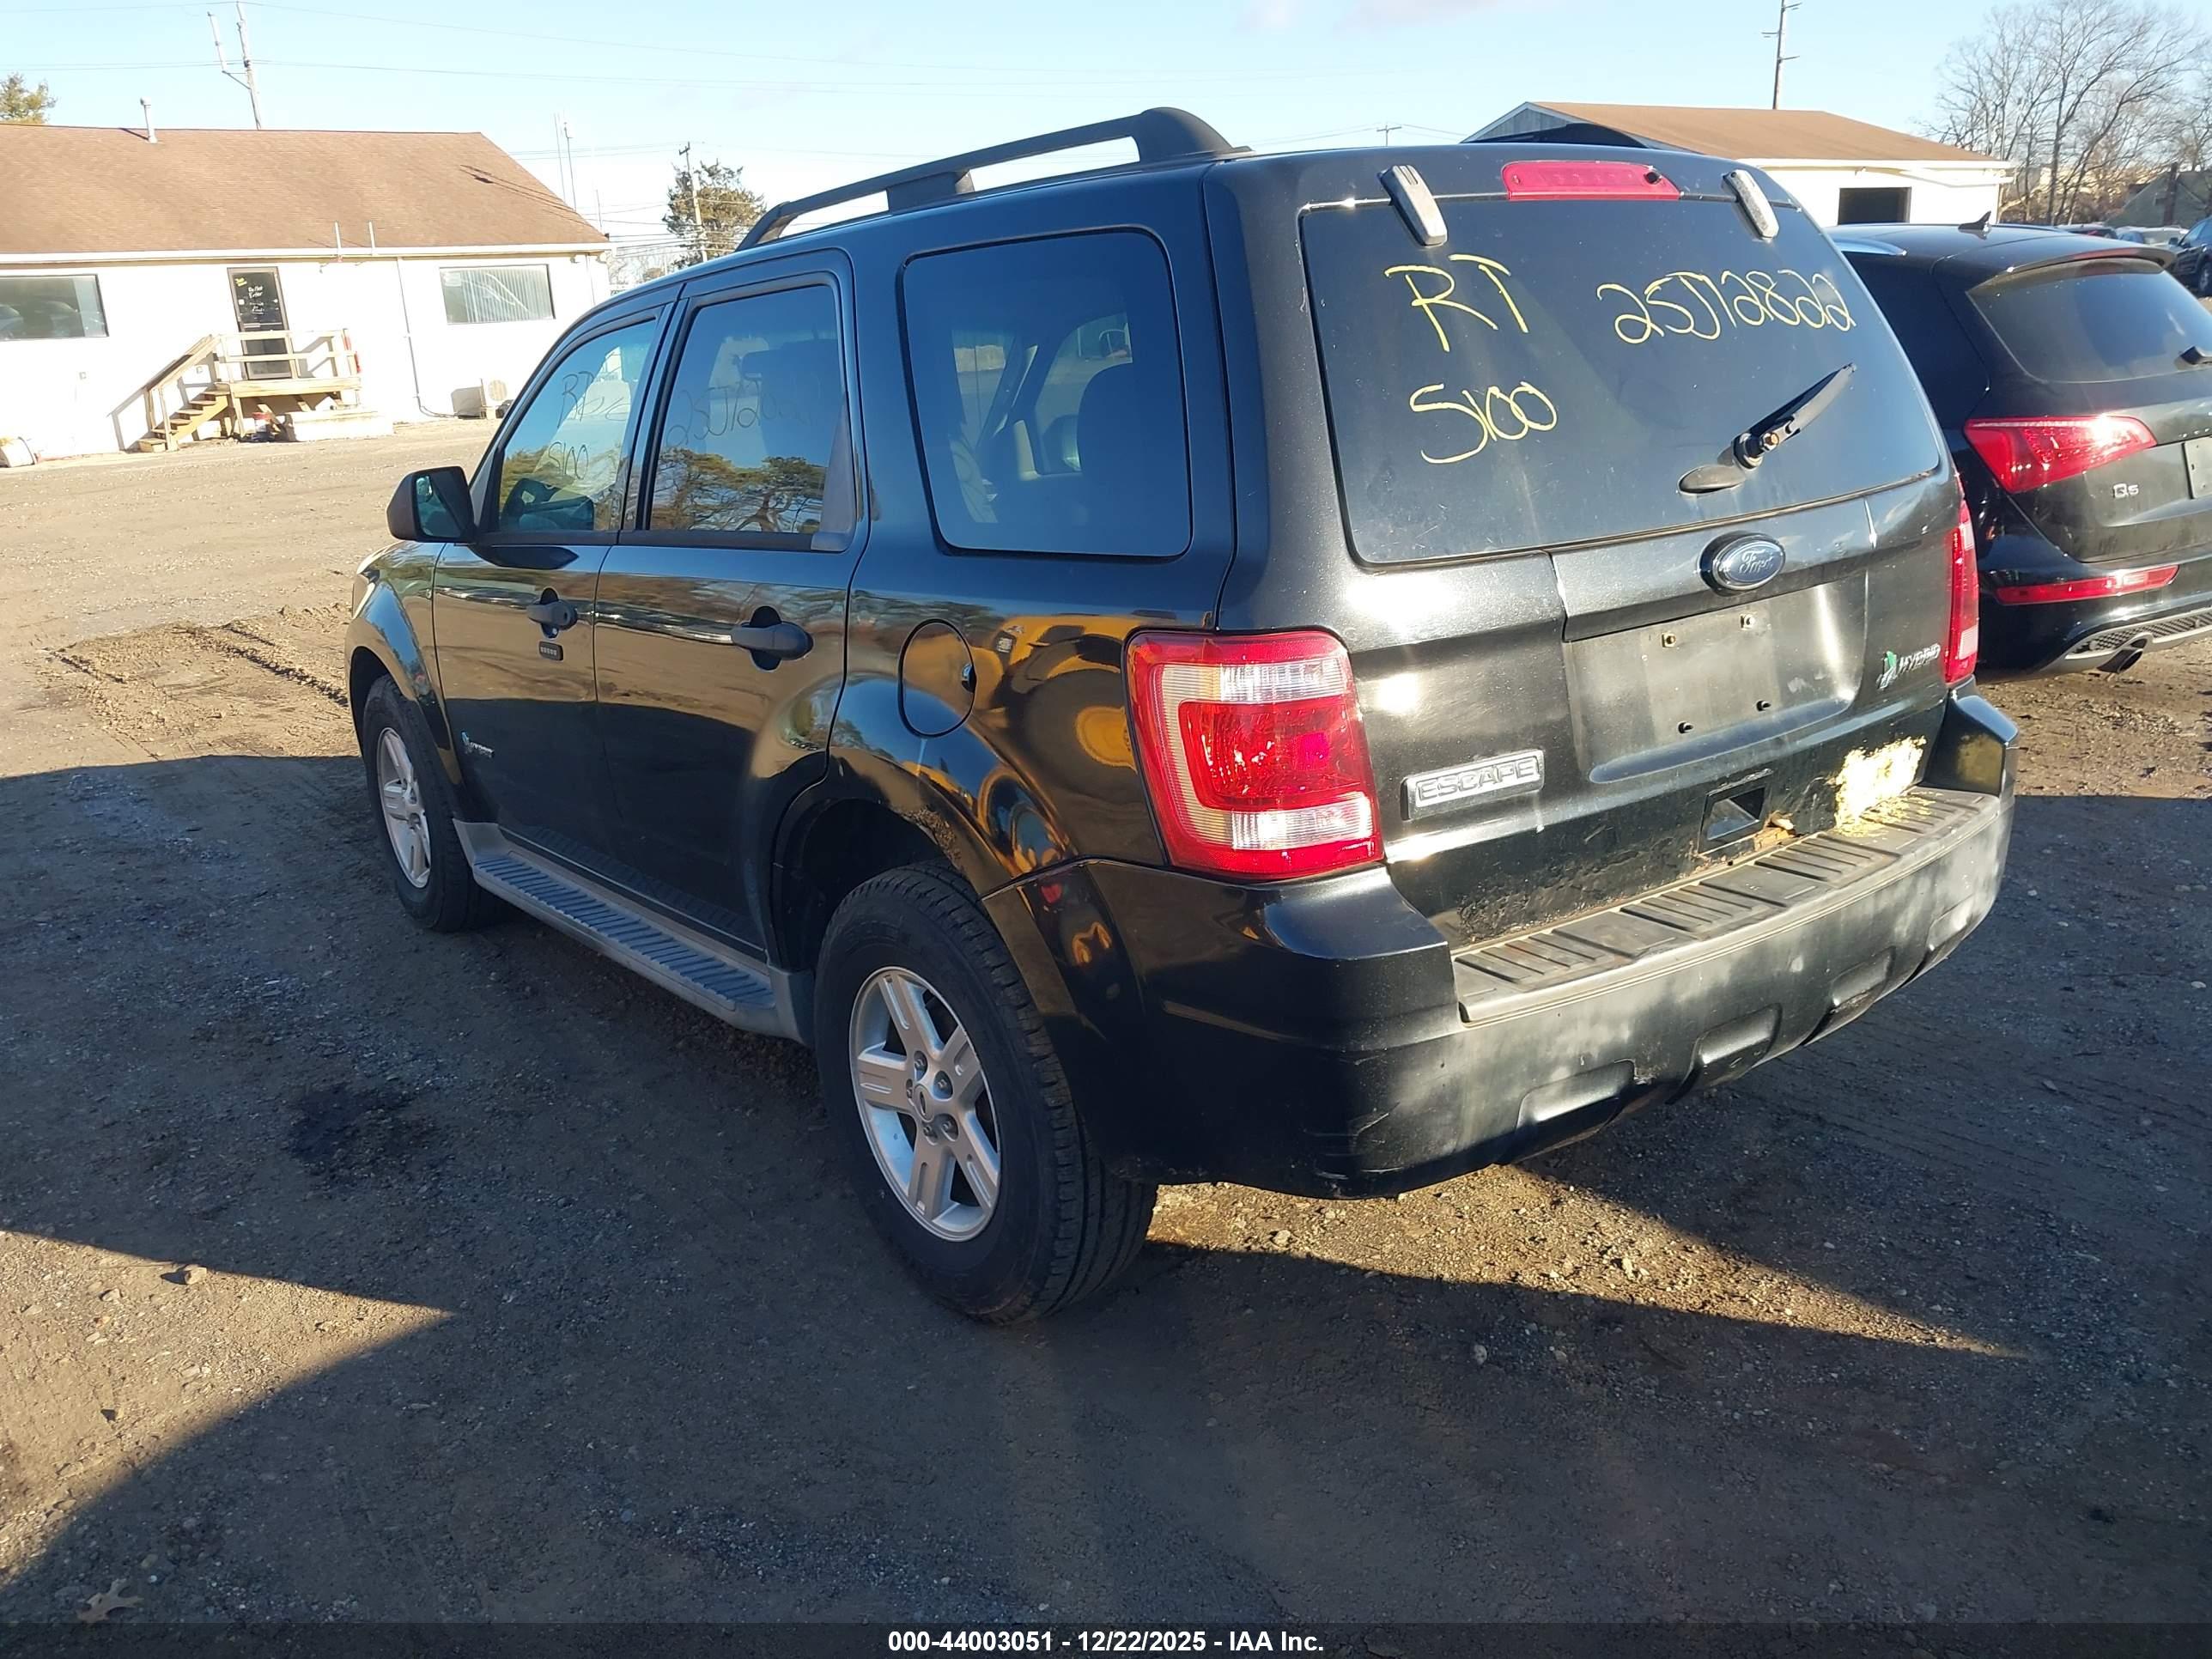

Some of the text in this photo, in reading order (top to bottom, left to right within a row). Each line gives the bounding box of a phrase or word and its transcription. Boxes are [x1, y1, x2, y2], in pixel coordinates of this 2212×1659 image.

[1385, 253, 1529, 352] RT
[2113, 483, 2139, 498] Q5
[1739, 549, 1774, 574] Ford
[1418, 757, 1539, 802] ESCAPE
